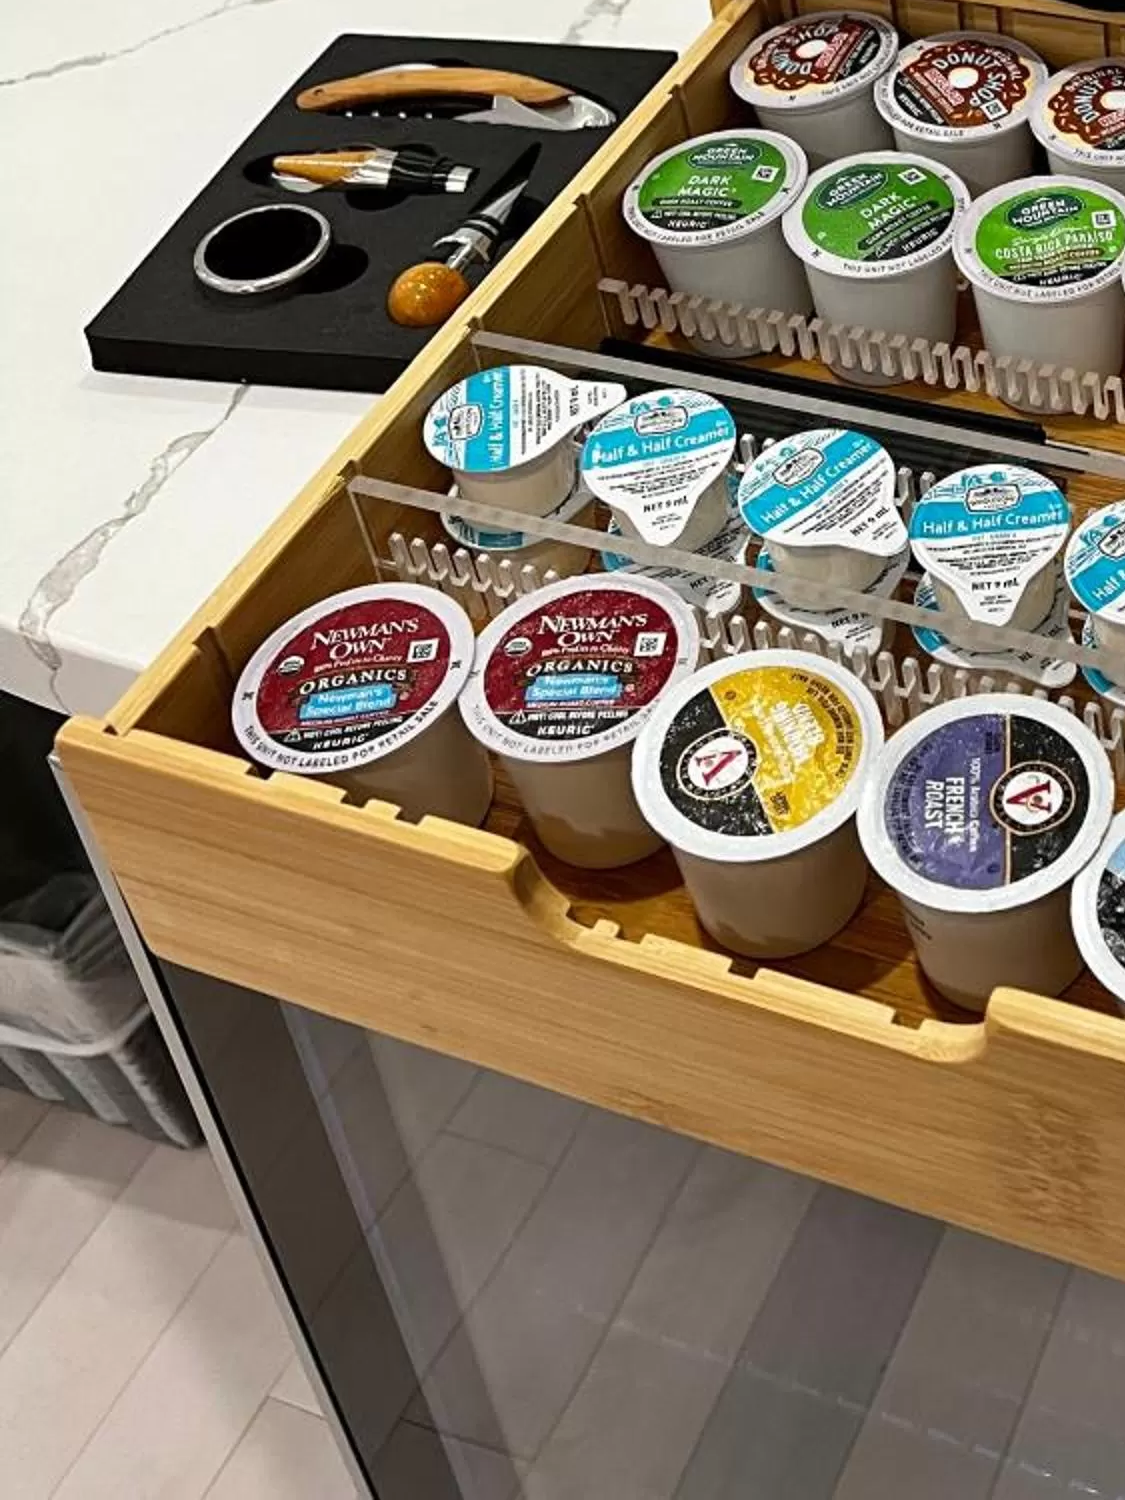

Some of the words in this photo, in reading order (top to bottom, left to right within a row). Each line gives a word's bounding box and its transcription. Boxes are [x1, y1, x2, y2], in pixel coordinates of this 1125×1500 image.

[932, 50, 1003, 71] DONUT
[969, 72, 1007, 107] SHOP
[1073, 81, 1104, 124] DONUT
[687, 174, 733, 185] DARK
[677, 186, 730, 198] MAGIC
[860, 192, 901, 219] DARK
[868, 198, 914, 231] MAGIC
[1011, 205, 1079, 225] MOUNTAIN
[1021, 199, 1066, 215] GREEN
[995, 243, 1032, 260] COSTA
[1035, 238, 1062, 255] RICA
[591, 445, 625, 465] Half
[627, 444, 639, 457] &
[643, 436, 672, 453] Half
[674, 426, 729, 448] Creamer
[759, 503, 790, 525] Half
[787, 494, 801, 507] &
[799, 474, 828, 500] Half
[825, 441, 874, 477] Creamer
[923, 519, 954, 535] Half
[957, 519, 969, 531] &
[973, 515, 1002, 530] Half
[1005, 510, 1064, 526] Creamer
[1092, 575, 1122, 600] Half
[311, 618, 419, 650] NEWMAN'S
[536, 613, 648, 635] NEWMAN'S
[329, 639, 386, 660] OWN
[557, 631, 616, 647] OWN
[526, 659, 633, 677] ORGANICS
[300, 669, 408, 695] ORGANICS
[531, 686, 577, 699] Special
[579, 683, 617, 696] Blend
[543, 676, 609, 686] Newman's
[317, 688, 383, 704] Newman's
[306, 701, 353, 717] Special
[277, 753, 298, 765] NOT
[298, 754, 350, 767] LABELED
[377, 722, 415, 749] RETAIL
[415, 699, 440, 723] SALE
[537, 724, 593, 736] KEURIG
[312, 734, 369, 750] KEURIG
[522, 743, 574, 755] LABELED
[924, 779, 945, 829] ROAST
[945, 776, 965, 834] FRENCH
